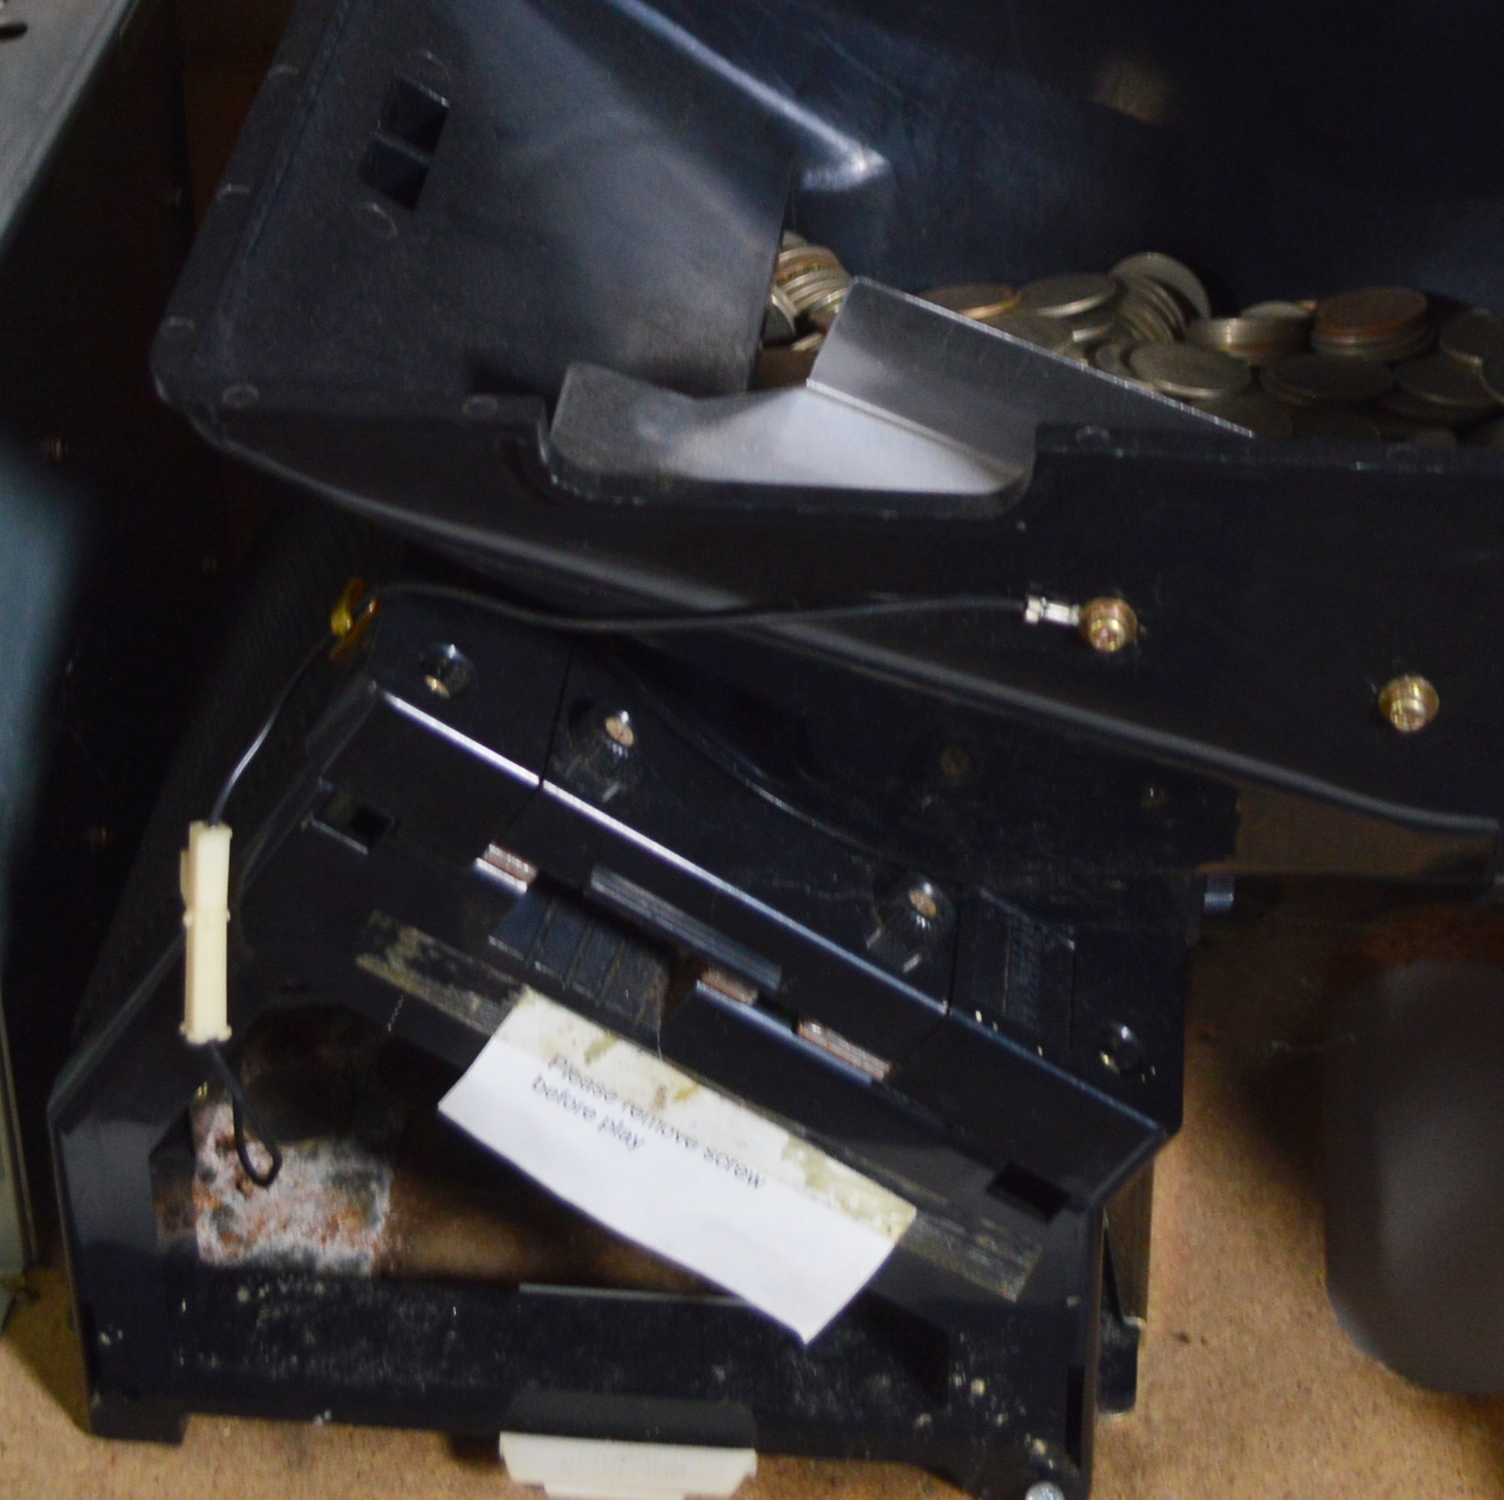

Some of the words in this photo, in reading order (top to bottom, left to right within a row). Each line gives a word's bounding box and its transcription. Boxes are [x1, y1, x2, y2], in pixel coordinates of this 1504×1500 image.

[532, 1073, 598, 1123] before
[597, 1113, 645, 1151] play
[548, 1053, 618, 1102] Please
[621, 1100, 699, 1151] remove
[703, 1143, 766, 1190] screw
